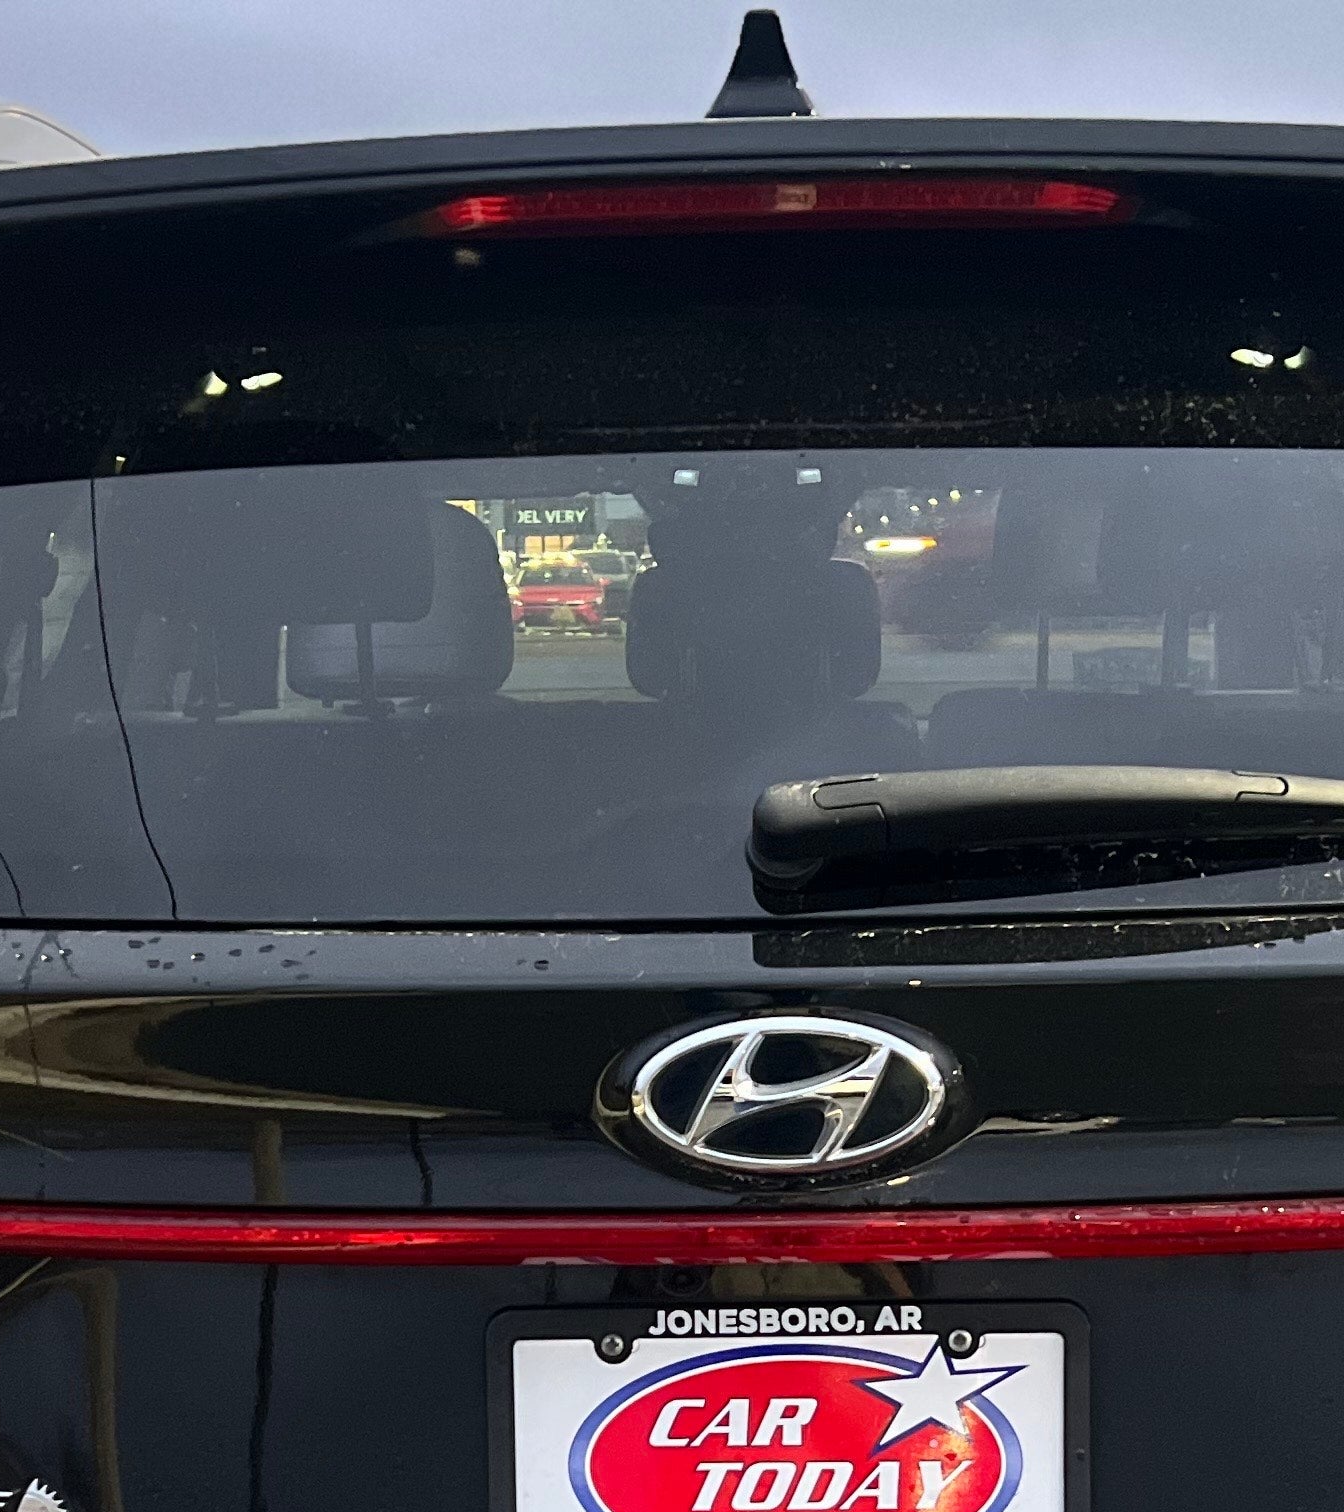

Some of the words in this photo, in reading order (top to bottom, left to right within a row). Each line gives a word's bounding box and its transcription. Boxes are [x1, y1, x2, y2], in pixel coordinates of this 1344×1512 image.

[649, 1308, 866, 1336] JONESBORO,
[875, 1306, 923, 1331] AR
[648, 1398, 817, 1447] CAR
[693, 1460, 973, 1512] TODAY
